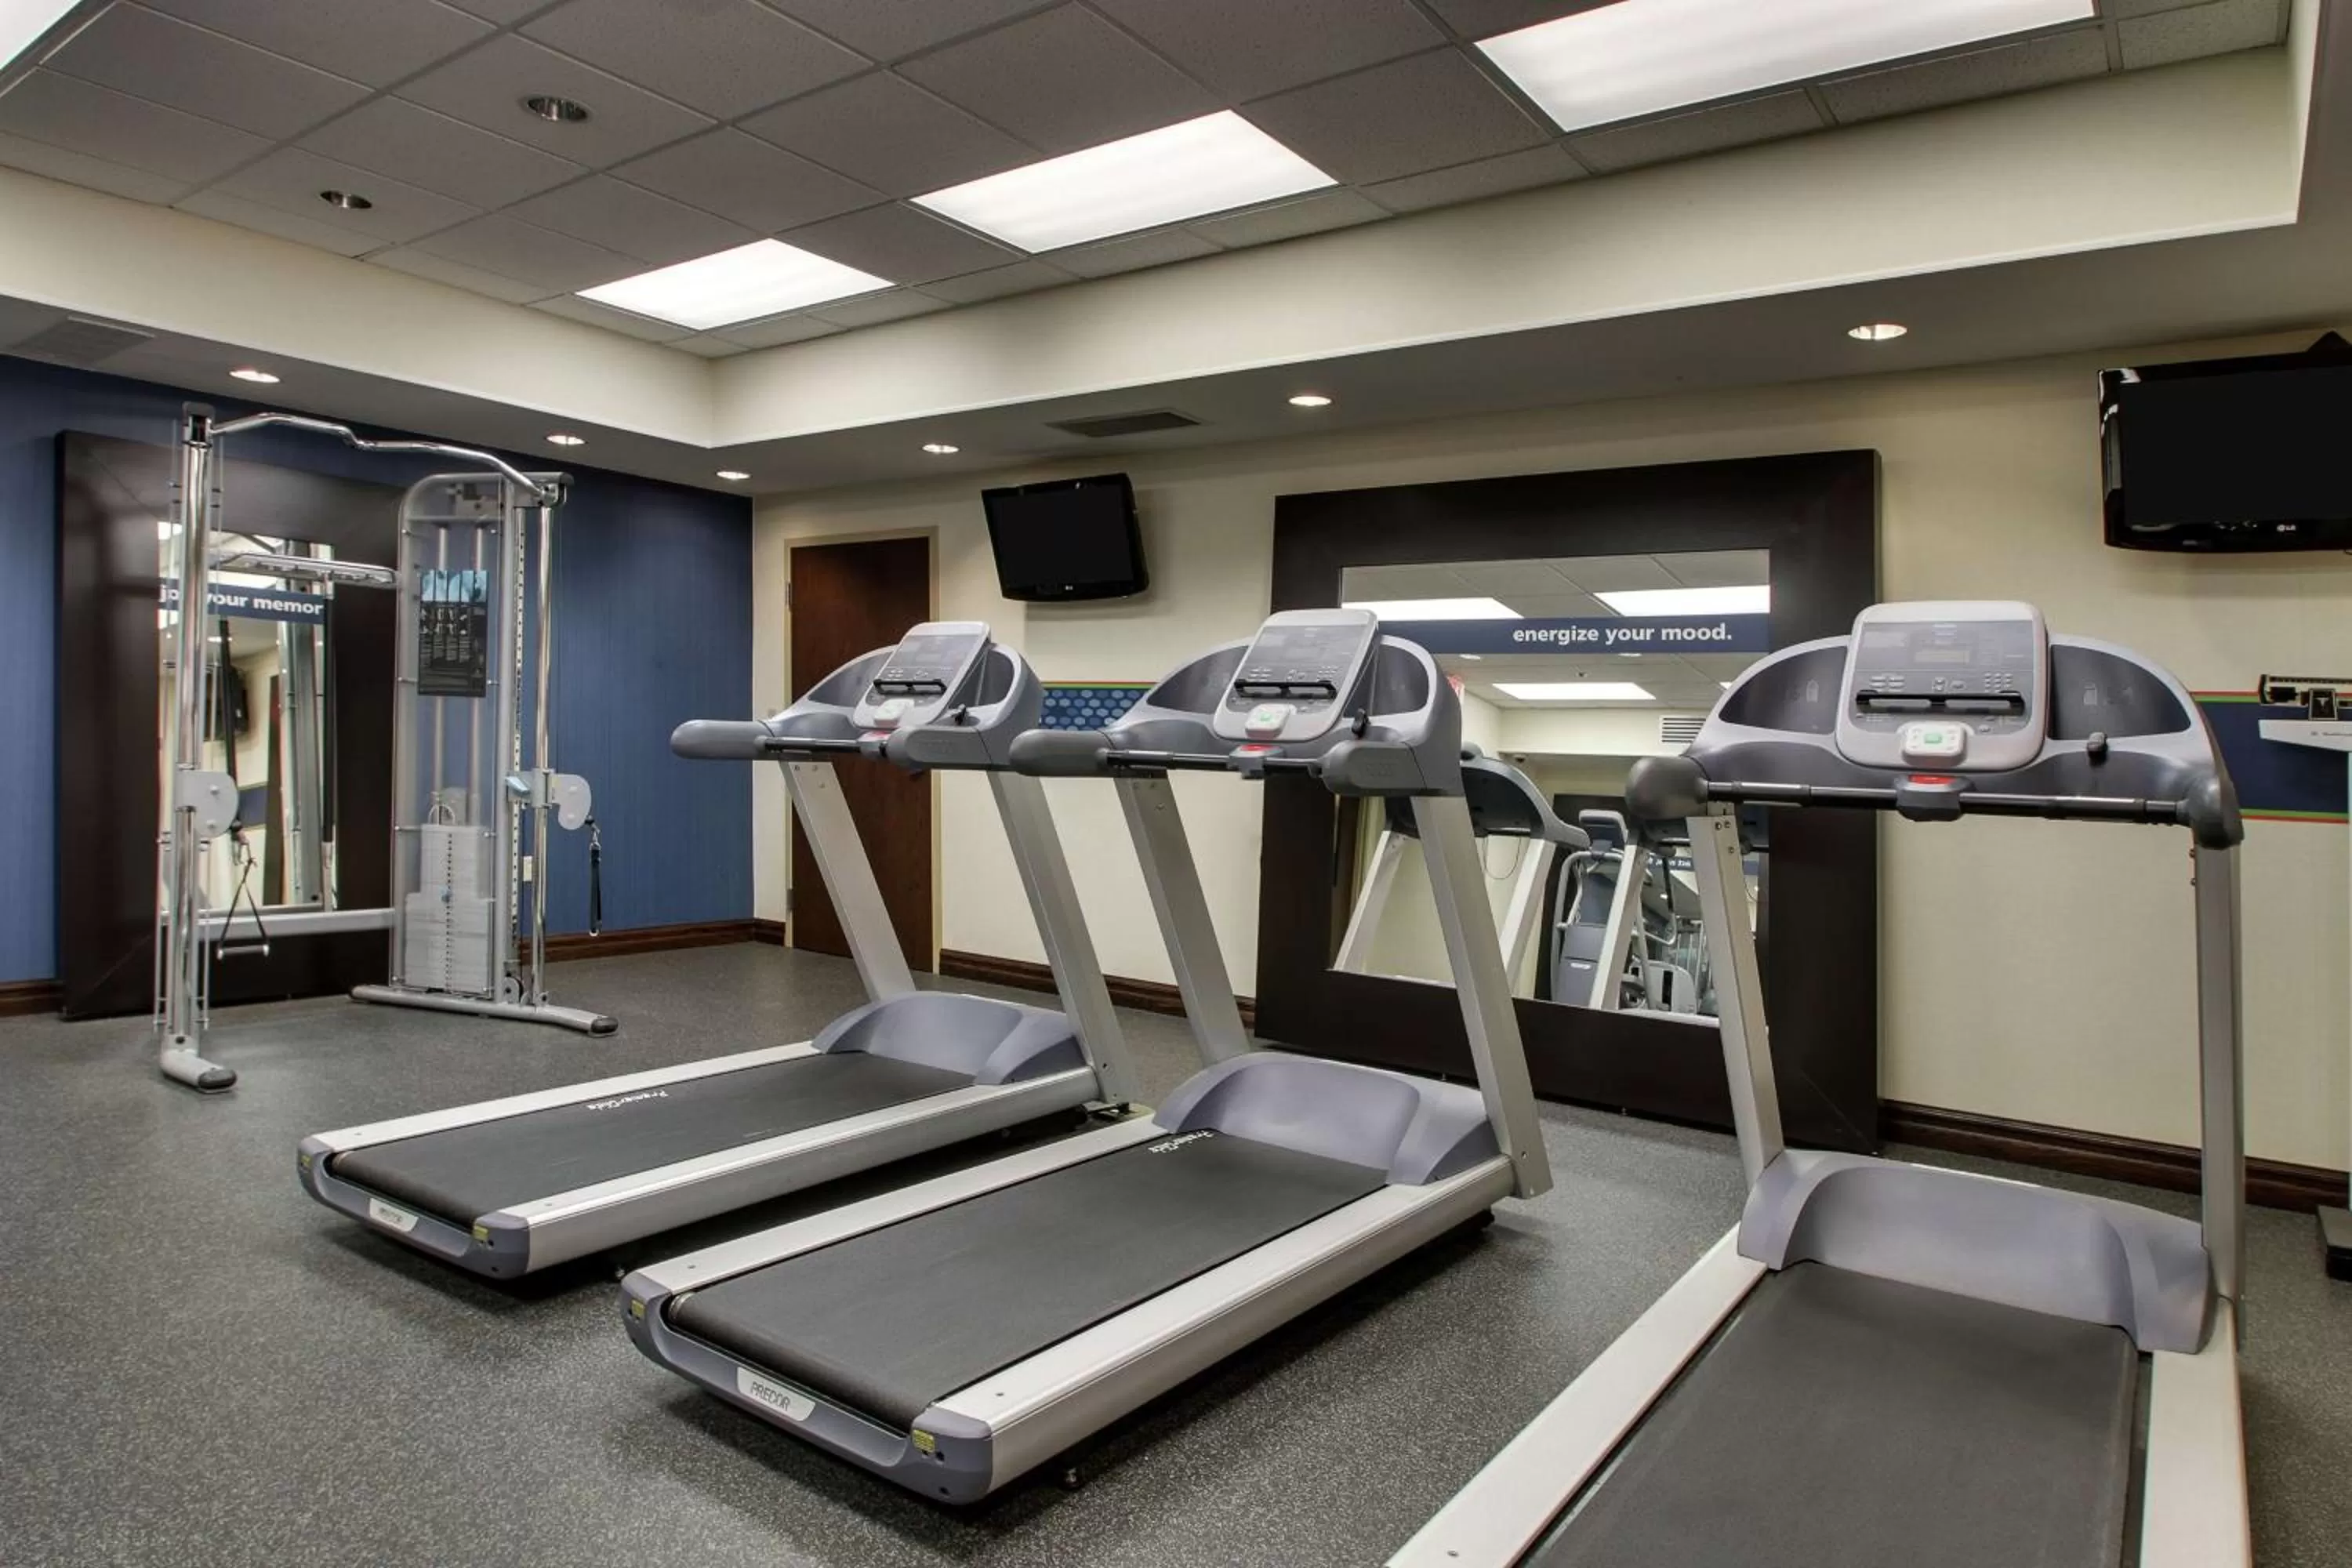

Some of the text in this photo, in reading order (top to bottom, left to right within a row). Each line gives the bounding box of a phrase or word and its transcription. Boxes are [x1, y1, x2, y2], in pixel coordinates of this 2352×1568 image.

[1513, 622, 1733, 645] energize your mood.
[750, 1381, 791, 1412] PRECOR
